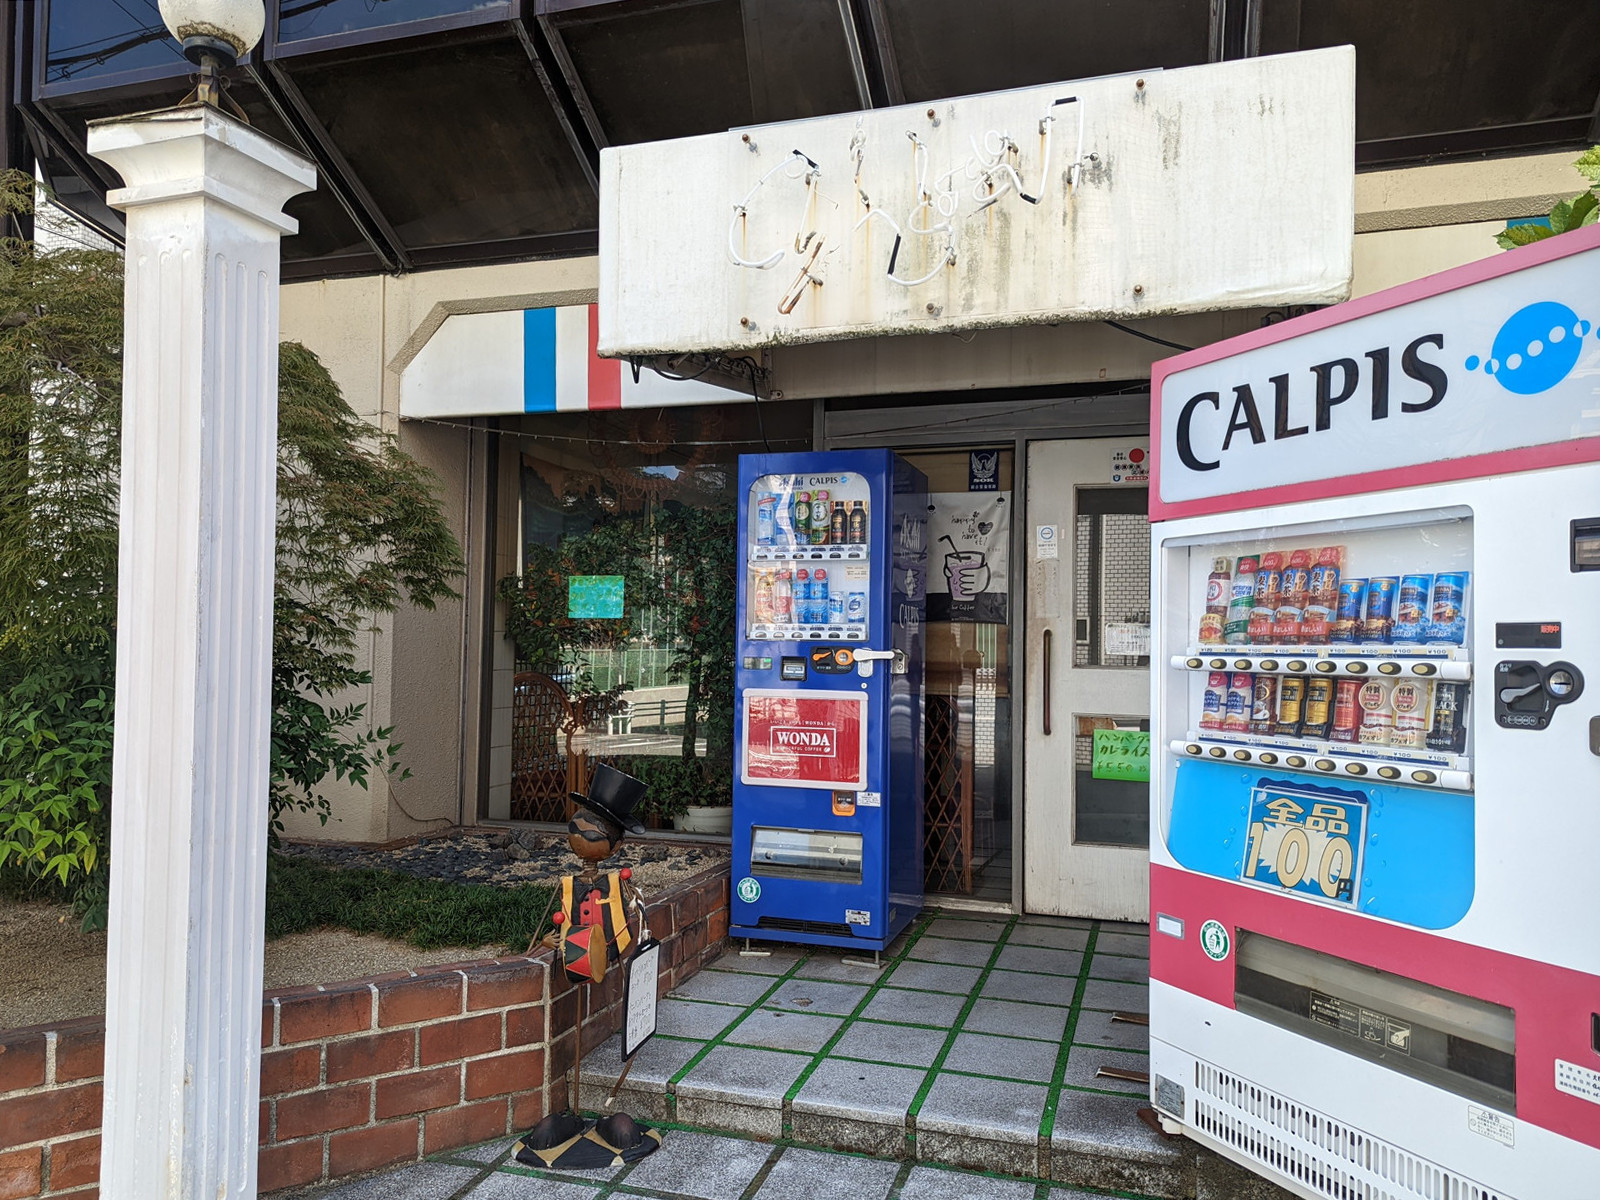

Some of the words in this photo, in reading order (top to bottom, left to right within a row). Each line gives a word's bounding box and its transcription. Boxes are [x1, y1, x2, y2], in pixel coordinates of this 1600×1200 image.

[1175, 333, 1449, 472] CALPIS
[779, 476, 804, 487] Ashi
[809, 475, 839, 487] CALPIS
[951, 515, 976, 525] happy
[968, 525, 976, 533] to
[961, 532, 979, 540] have
[1365, 685, 1381, 694] 特製
[1398, 687, 1414, 696] 特製
[776, 731, 830, 746] WONDA
[1263, 797, 1350, 836] 全品
[1245, 822, 1354, 898] 100
[1335, 877, 1354, 901] 円
